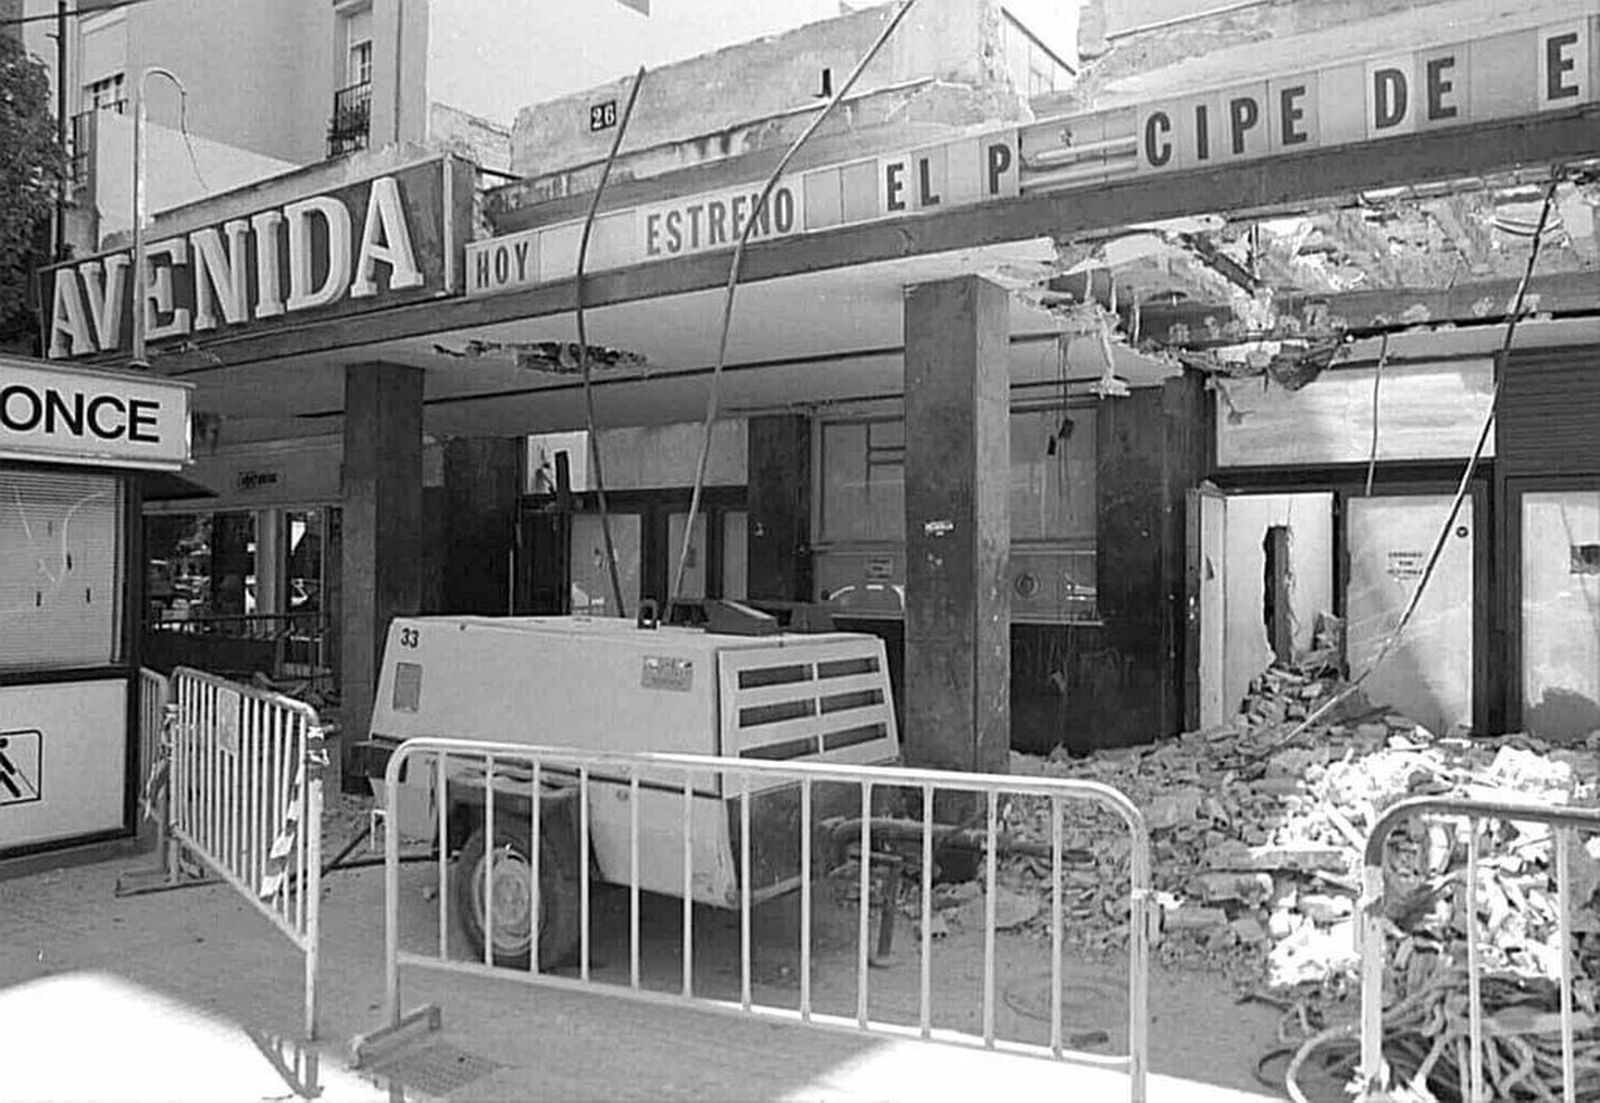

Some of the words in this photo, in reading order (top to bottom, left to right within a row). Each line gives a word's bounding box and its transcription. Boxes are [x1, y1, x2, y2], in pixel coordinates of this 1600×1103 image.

[592, 104, 615, 128] 26
[476, 241, 529, 289] HOY
[646, 187, 795, 256] ESTRENO
[886, 157, 941, 212] EL
[1374, 56, 1458, 130] DE
[1546, 32, 1579, 101] E
[48, 176, 424, 359] AVENIDA
[0, 384, 160, 444] ONCE
[400, 627, 420, 649] 33
